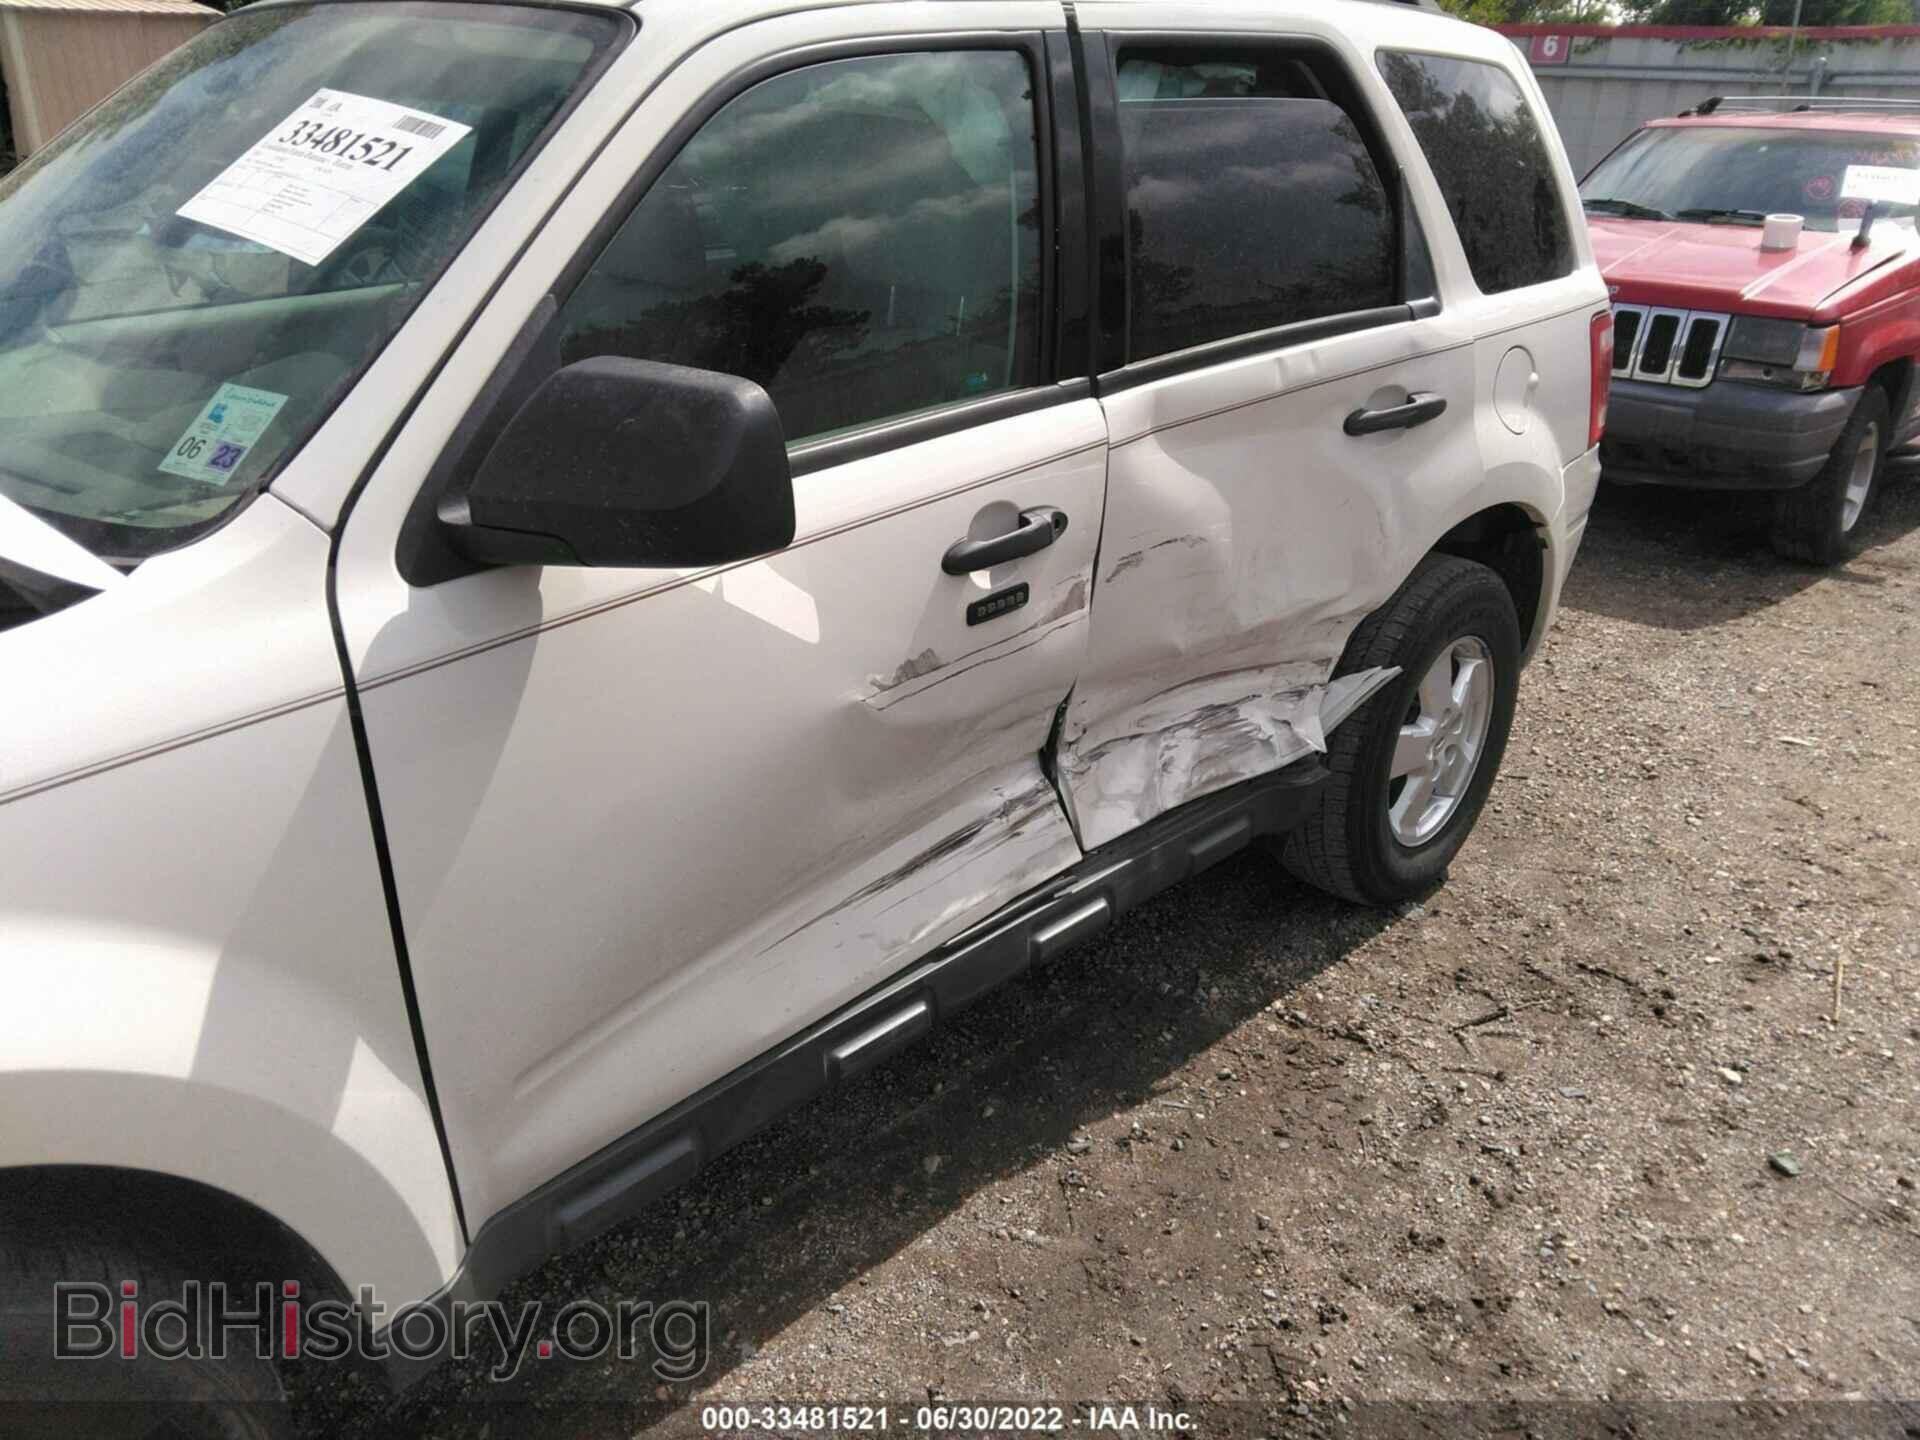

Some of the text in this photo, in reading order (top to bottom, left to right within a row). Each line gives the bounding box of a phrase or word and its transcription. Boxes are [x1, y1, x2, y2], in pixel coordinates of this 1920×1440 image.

[1543, 35, 1559, 57] 6
[278, 120, 413, 171] 33481521
[176, 436, 207, 459] 06
[210, 445, 242, 469] 23
